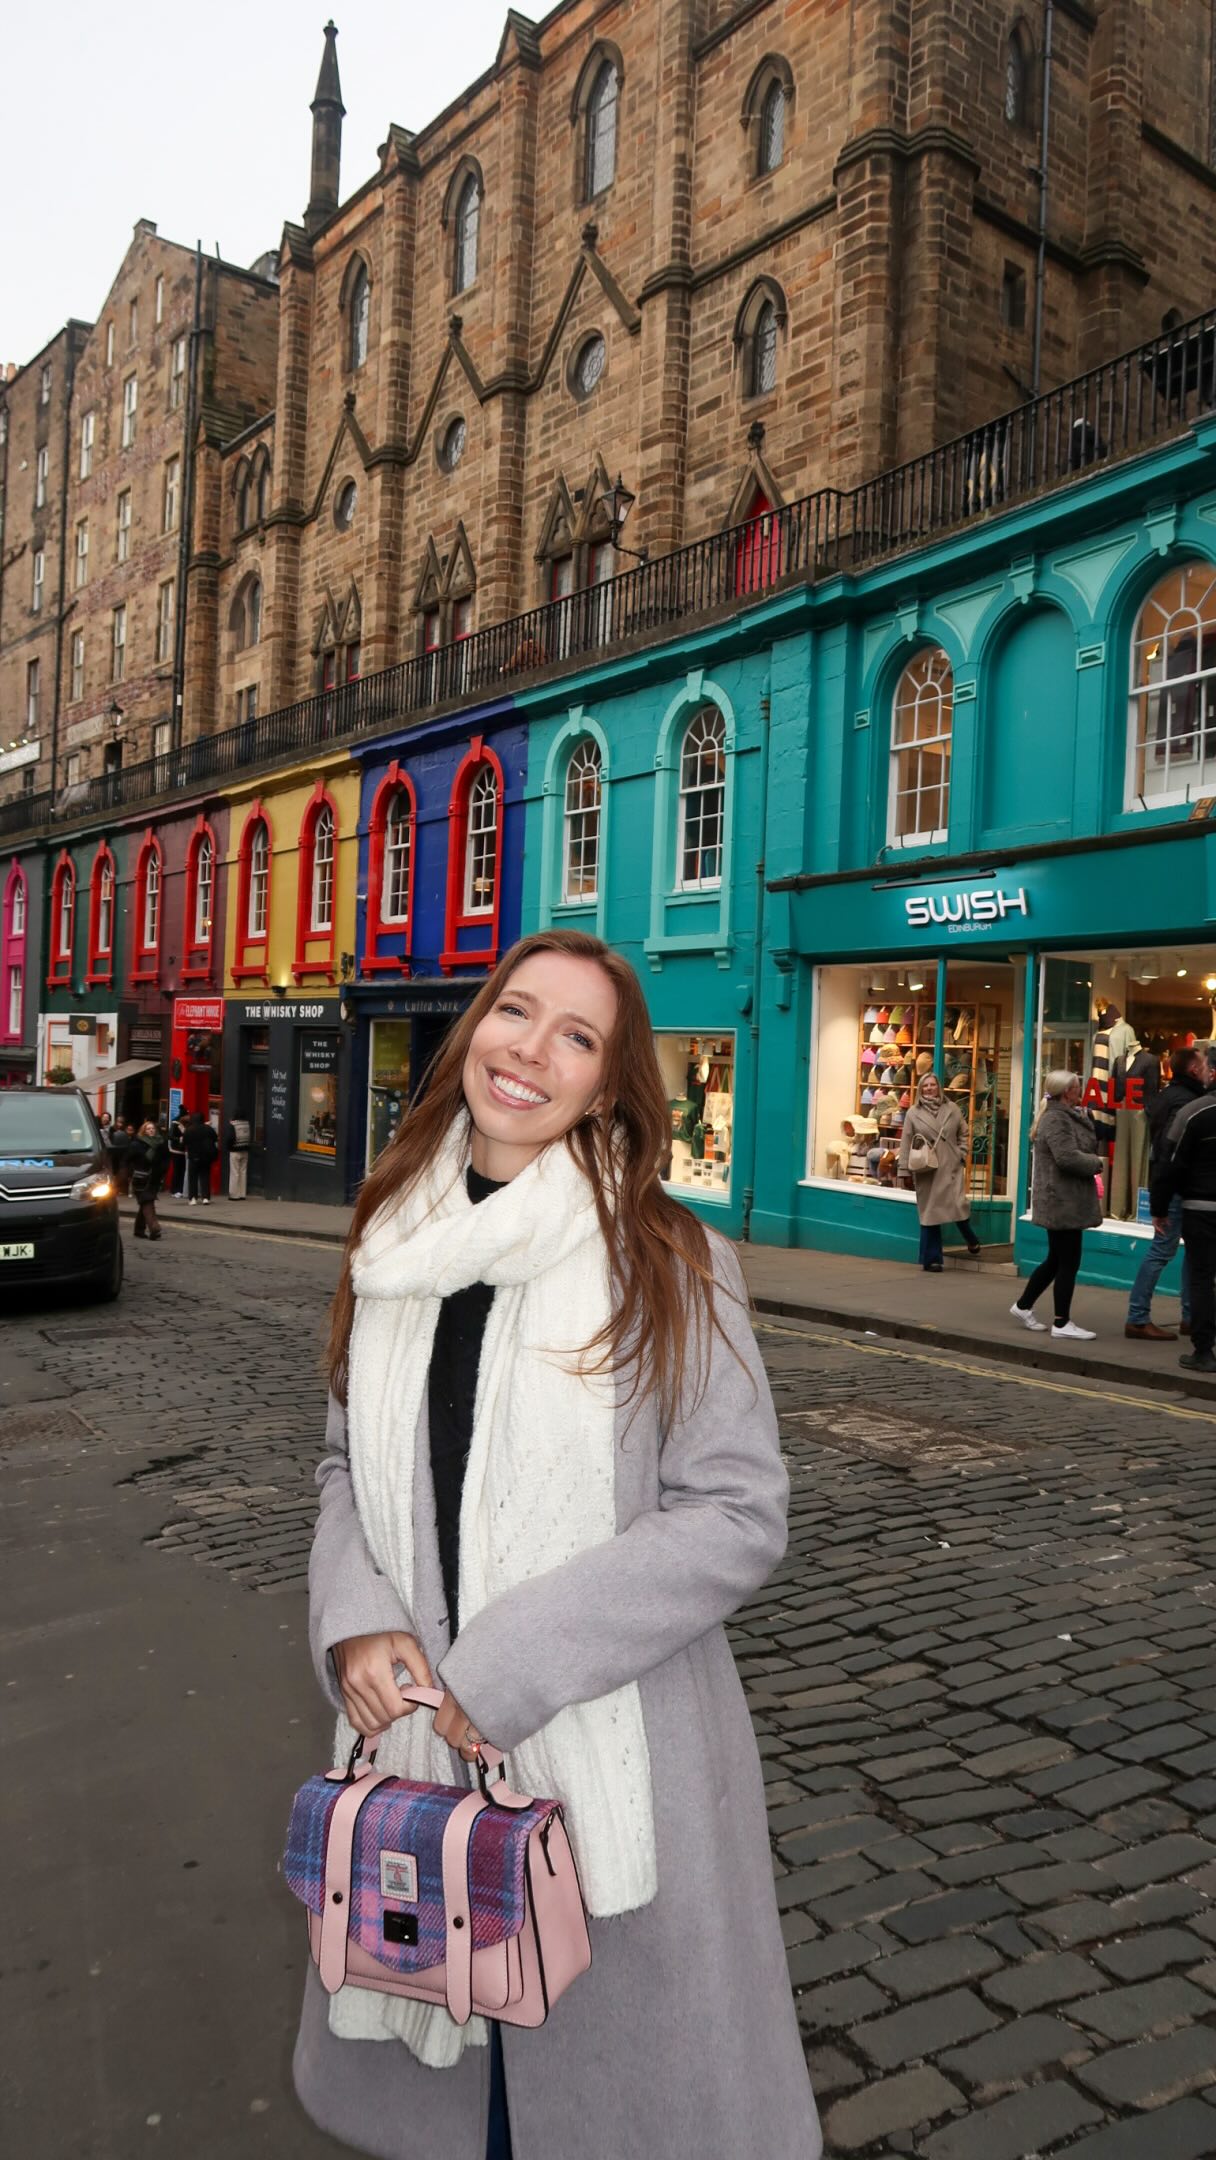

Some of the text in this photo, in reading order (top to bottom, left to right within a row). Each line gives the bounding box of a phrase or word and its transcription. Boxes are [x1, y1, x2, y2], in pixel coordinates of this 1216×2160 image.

[905, 887, 1027, 925] SWISH
[947, 923, 992, 934] EDINBURGH
[245, 1005, 324, 1018] THE WHISKY SHOP
[1081, 1077, 1145, 1110] ALE
[3, 1245, 28, 1257] WJK
